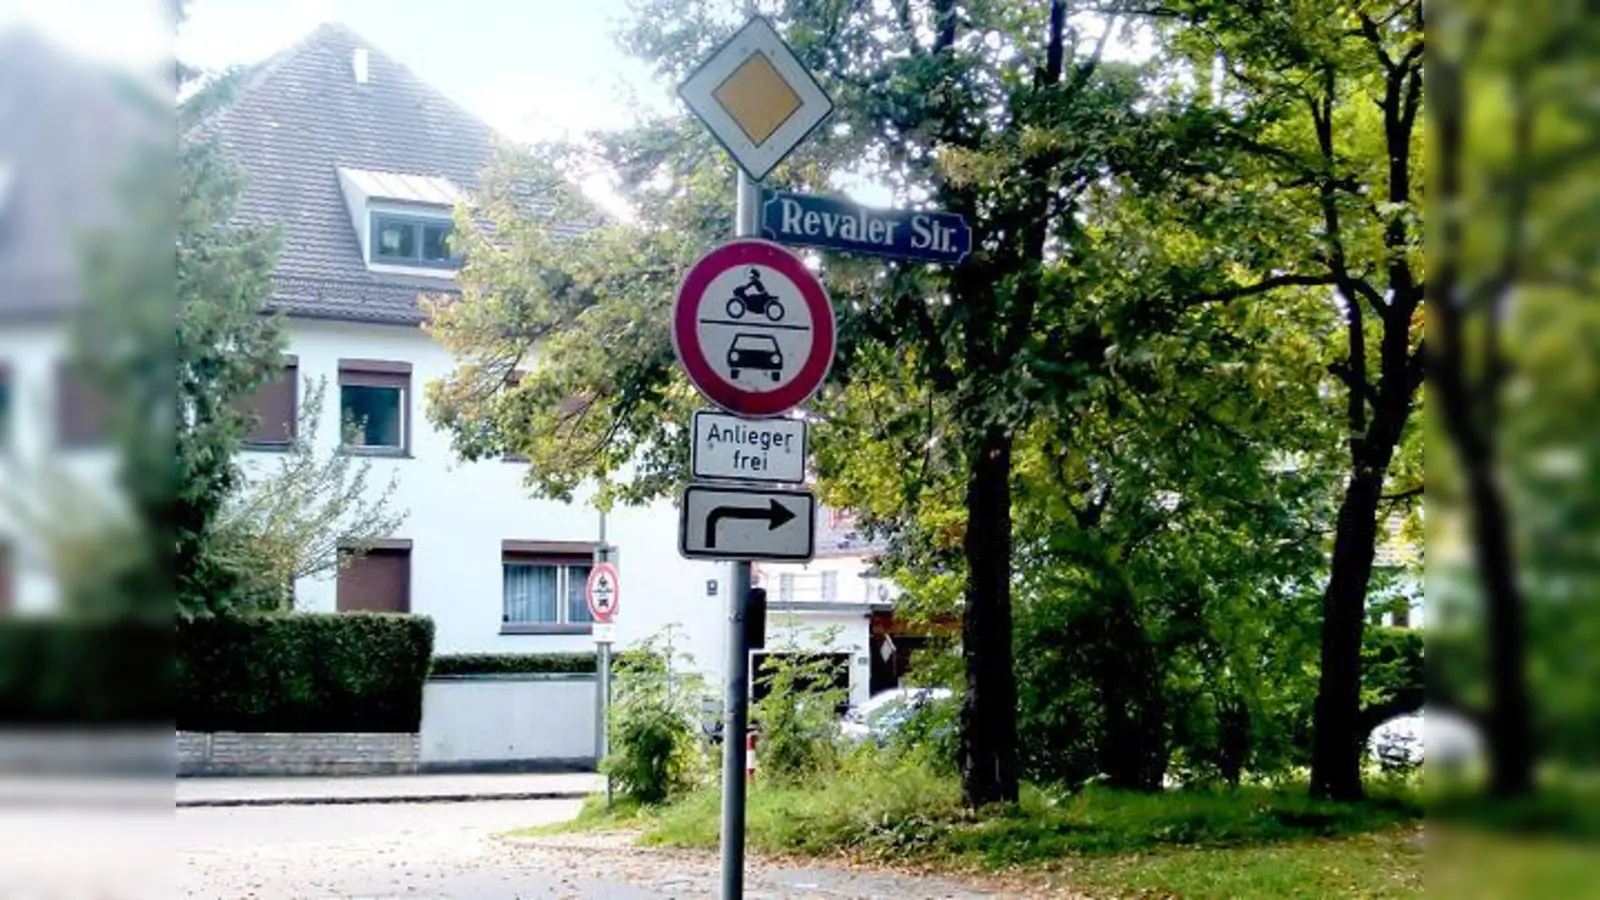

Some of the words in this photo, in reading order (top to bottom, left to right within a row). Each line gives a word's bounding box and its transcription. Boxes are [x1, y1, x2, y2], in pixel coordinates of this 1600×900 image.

[781, 198, 899, 245] Revaler
[911, 214, 957, 252] Str.
[707, 423, 793, 450] Anlieger
[733, 450, 768, 471] frei
